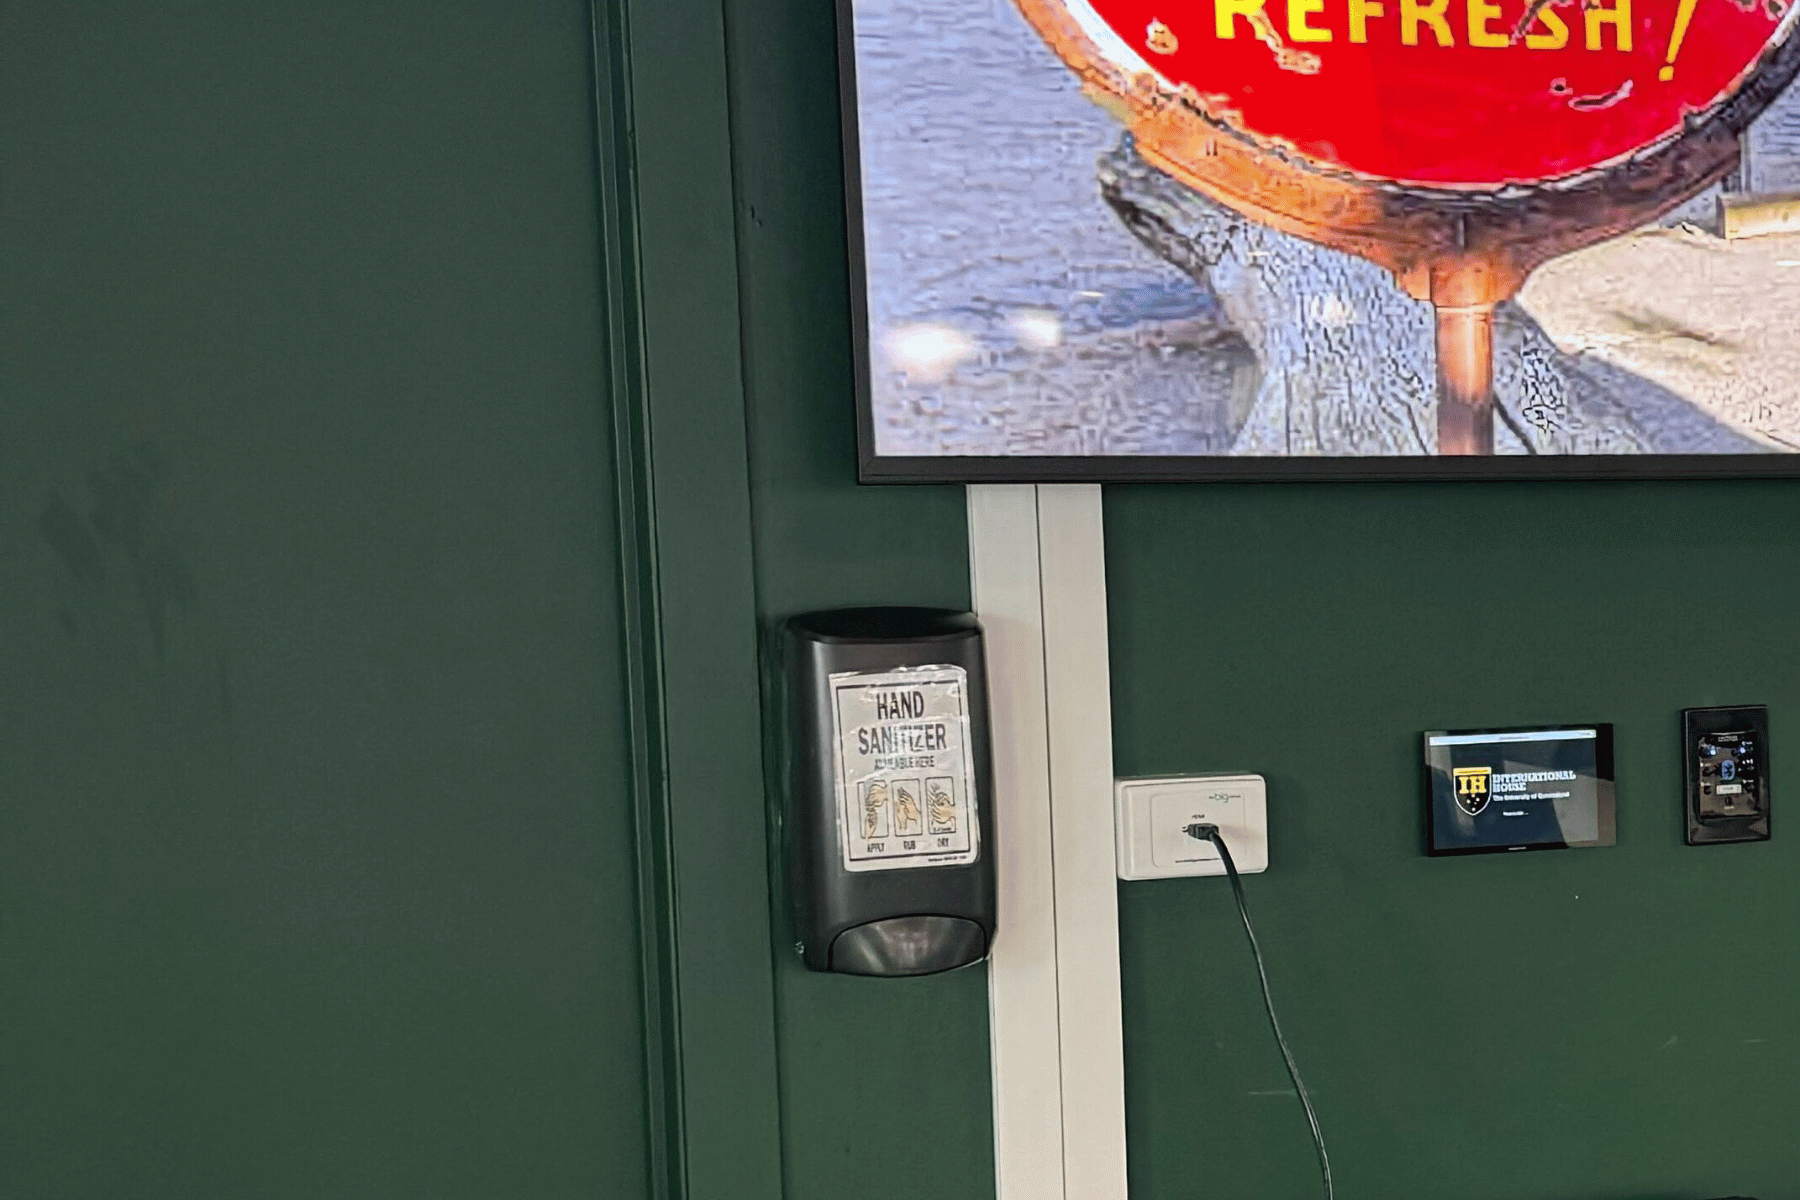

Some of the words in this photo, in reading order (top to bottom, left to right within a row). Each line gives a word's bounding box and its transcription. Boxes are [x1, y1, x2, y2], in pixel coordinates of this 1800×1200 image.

[876, 691, 925, 720] HAND
[858, 723, 947, 755] SANITIZER
[1459, 775, 1487, 794] IH
